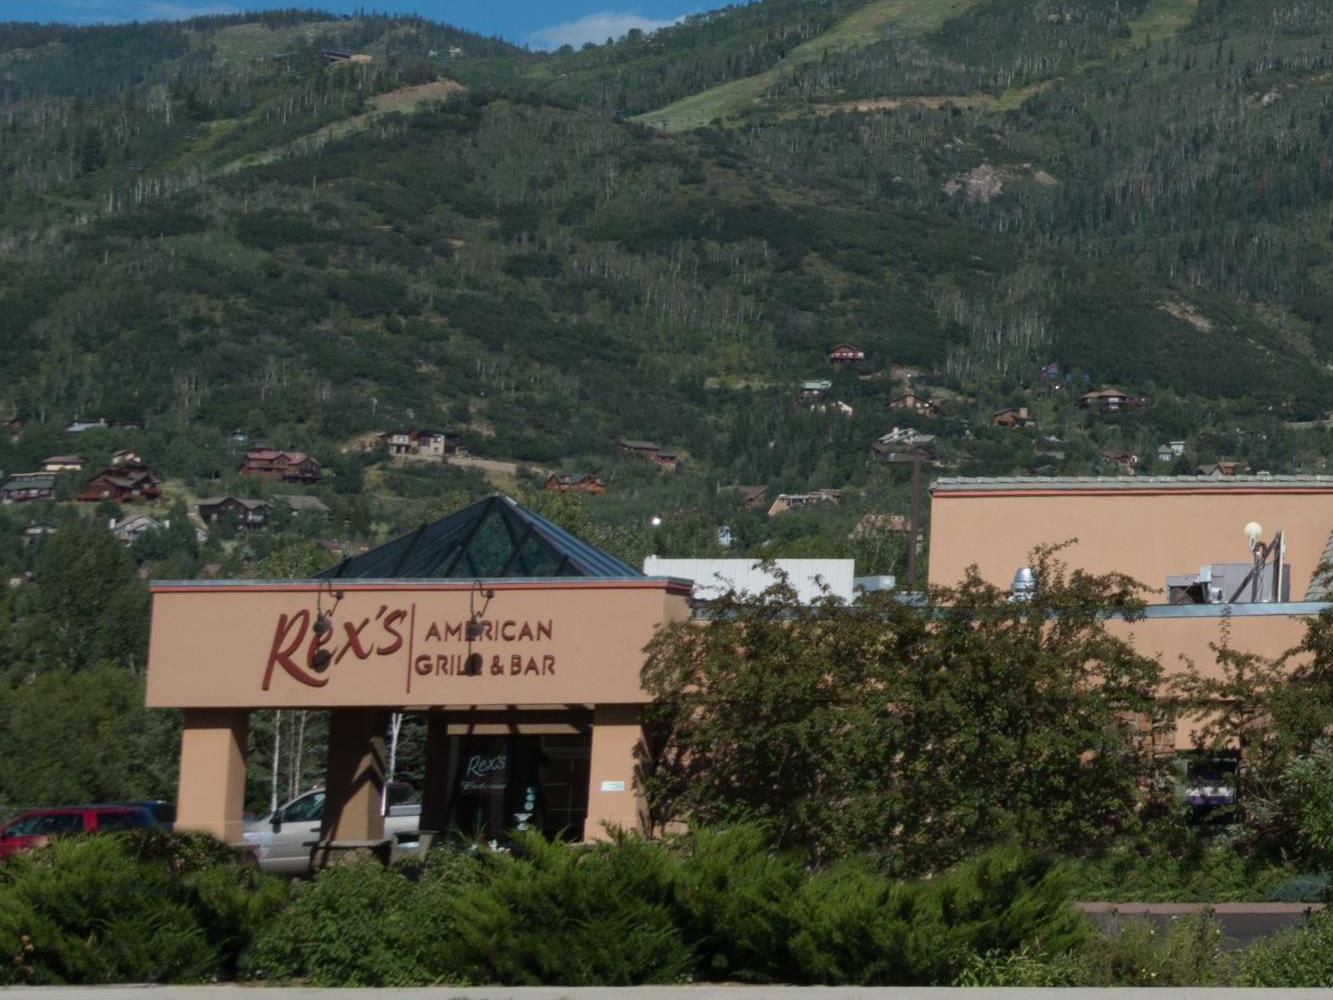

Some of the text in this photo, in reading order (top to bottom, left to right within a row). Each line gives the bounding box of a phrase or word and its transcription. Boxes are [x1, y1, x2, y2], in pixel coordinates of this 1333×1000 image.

[425, 619, 553, 642] AMERICAN
[490, 654, 504, 676] &
[510, 654, 556, 676] BAR
